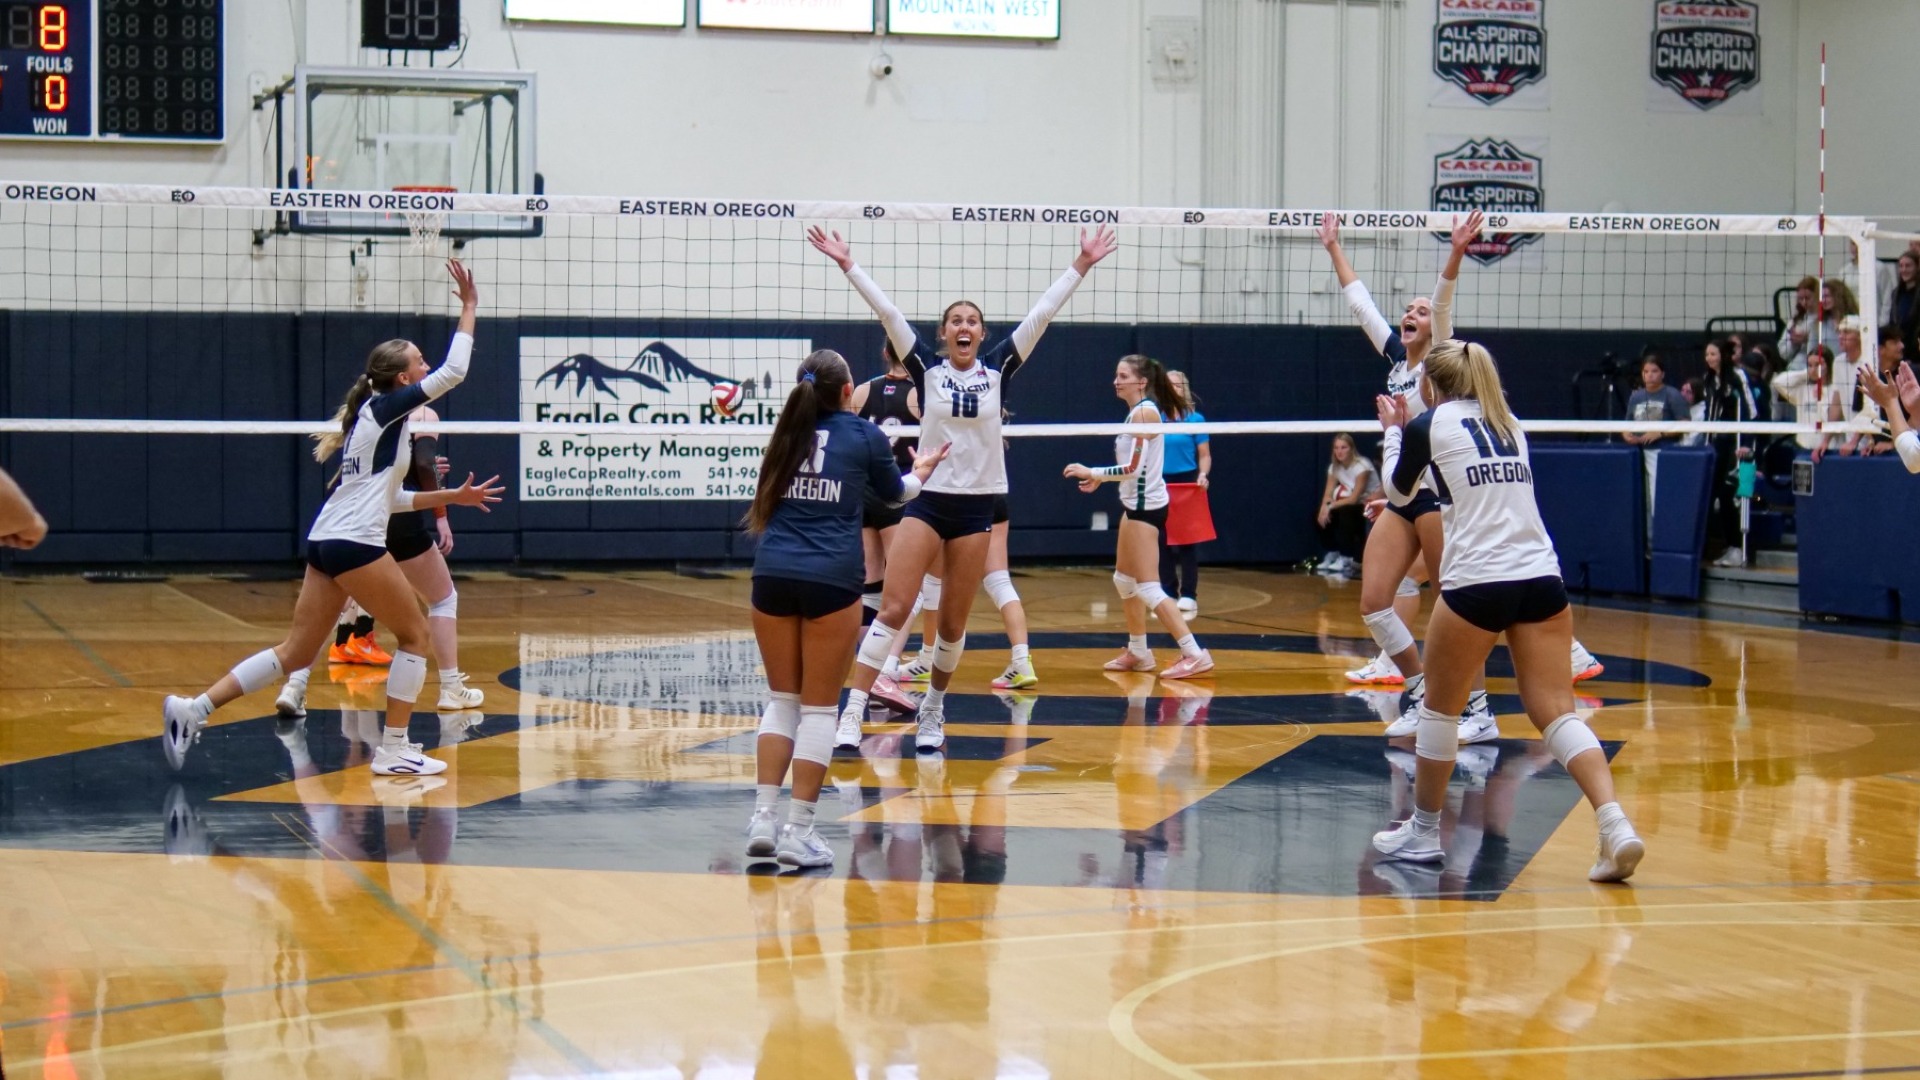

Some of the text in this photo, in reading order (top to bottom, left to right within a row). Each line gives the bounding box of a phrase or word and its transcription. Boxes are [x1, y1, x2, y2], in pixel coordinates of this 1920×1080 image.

[899, 0, 1049, 17] MOUNTAIN WEST
[1442, 0, 1536, 12] CASCADE
[1660, 4, 1751, 18] CASCADE
[40, 6, 65, 49] 8
[1442, 25, 1538, 43] ALL-SPORTS
[1660, 31, 1753, 49] ALL-SPORTS
[1439, 41, 1540, 66] CHAMPION
[1656, 47, 1755, 72] CHAMPION
[26, 56, 74, 74] FOULS
[45, 75, 65, 110] 0
[33, 117, 68, 135] WON
[1439, 160, 1533, 173] CASCADE
[5, 185, 97, 201] OREGON
[270, 192, 454, 210] EASTERN OREGON
[1439, 185, 1536, 203] ALL-SPORTS
[619, 200, 795, 218] EASTERN OREGON
[952, 207, 1119, 223] EASTERN OREGON
[1268, 212, 1427, 228] EASTEN OREGON
[1569, 216, 1720, 231] EASTERN OREGON
[951, 392, 979, 418] 10
[700, 402, 780, 428] Realt
[537, 440, 769, 462] & Property Manageme
[526, 466, 758, 483] EagleCapRealty.com 541-96
[1466, 461, 1532, 487] OREGON
[527, 484, 756, 498] LaGrandeRentals.com 541-96
[781, 476, 842, 503] REGON
